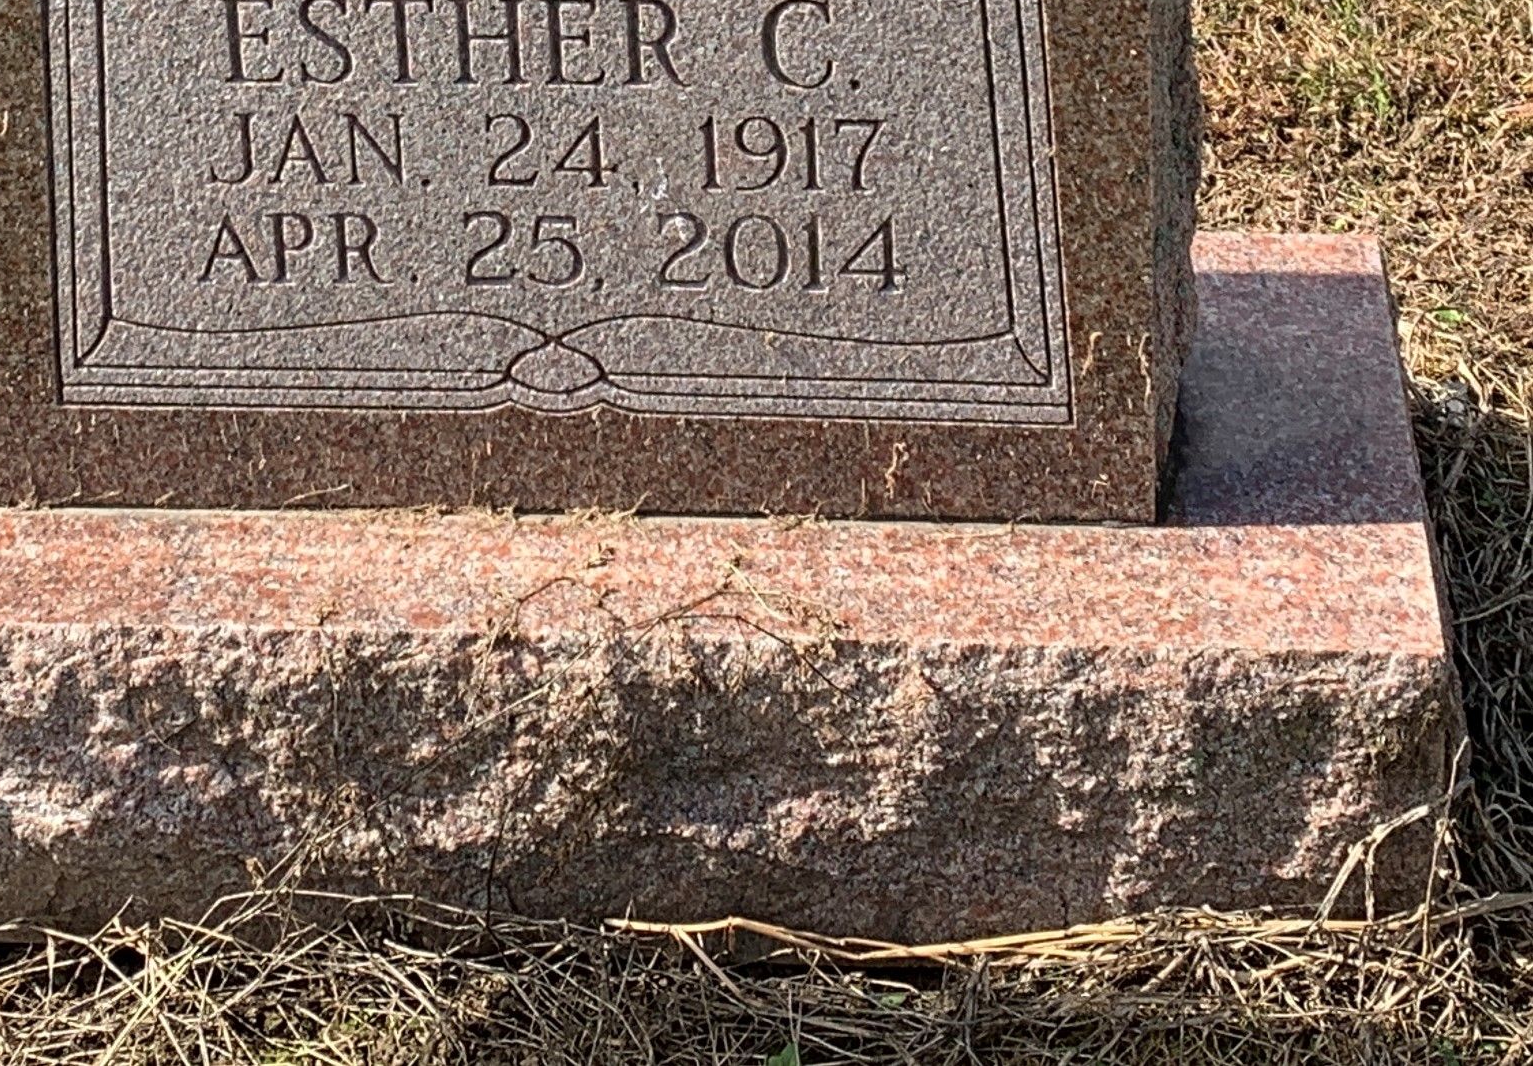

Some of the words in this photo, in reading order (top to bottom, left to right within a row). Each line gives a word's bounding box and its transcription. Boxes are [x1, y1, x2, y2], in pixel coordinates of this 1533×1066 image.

[208, 113, 432, 191] JAN.
[485, 111, 645, 196] 24,
[700, 114, 888, 192] 1917
[197, 211, 420, 287] APR.
[466, 209, 606, 292] 25,
[660, 214, 906, 292] 2014
